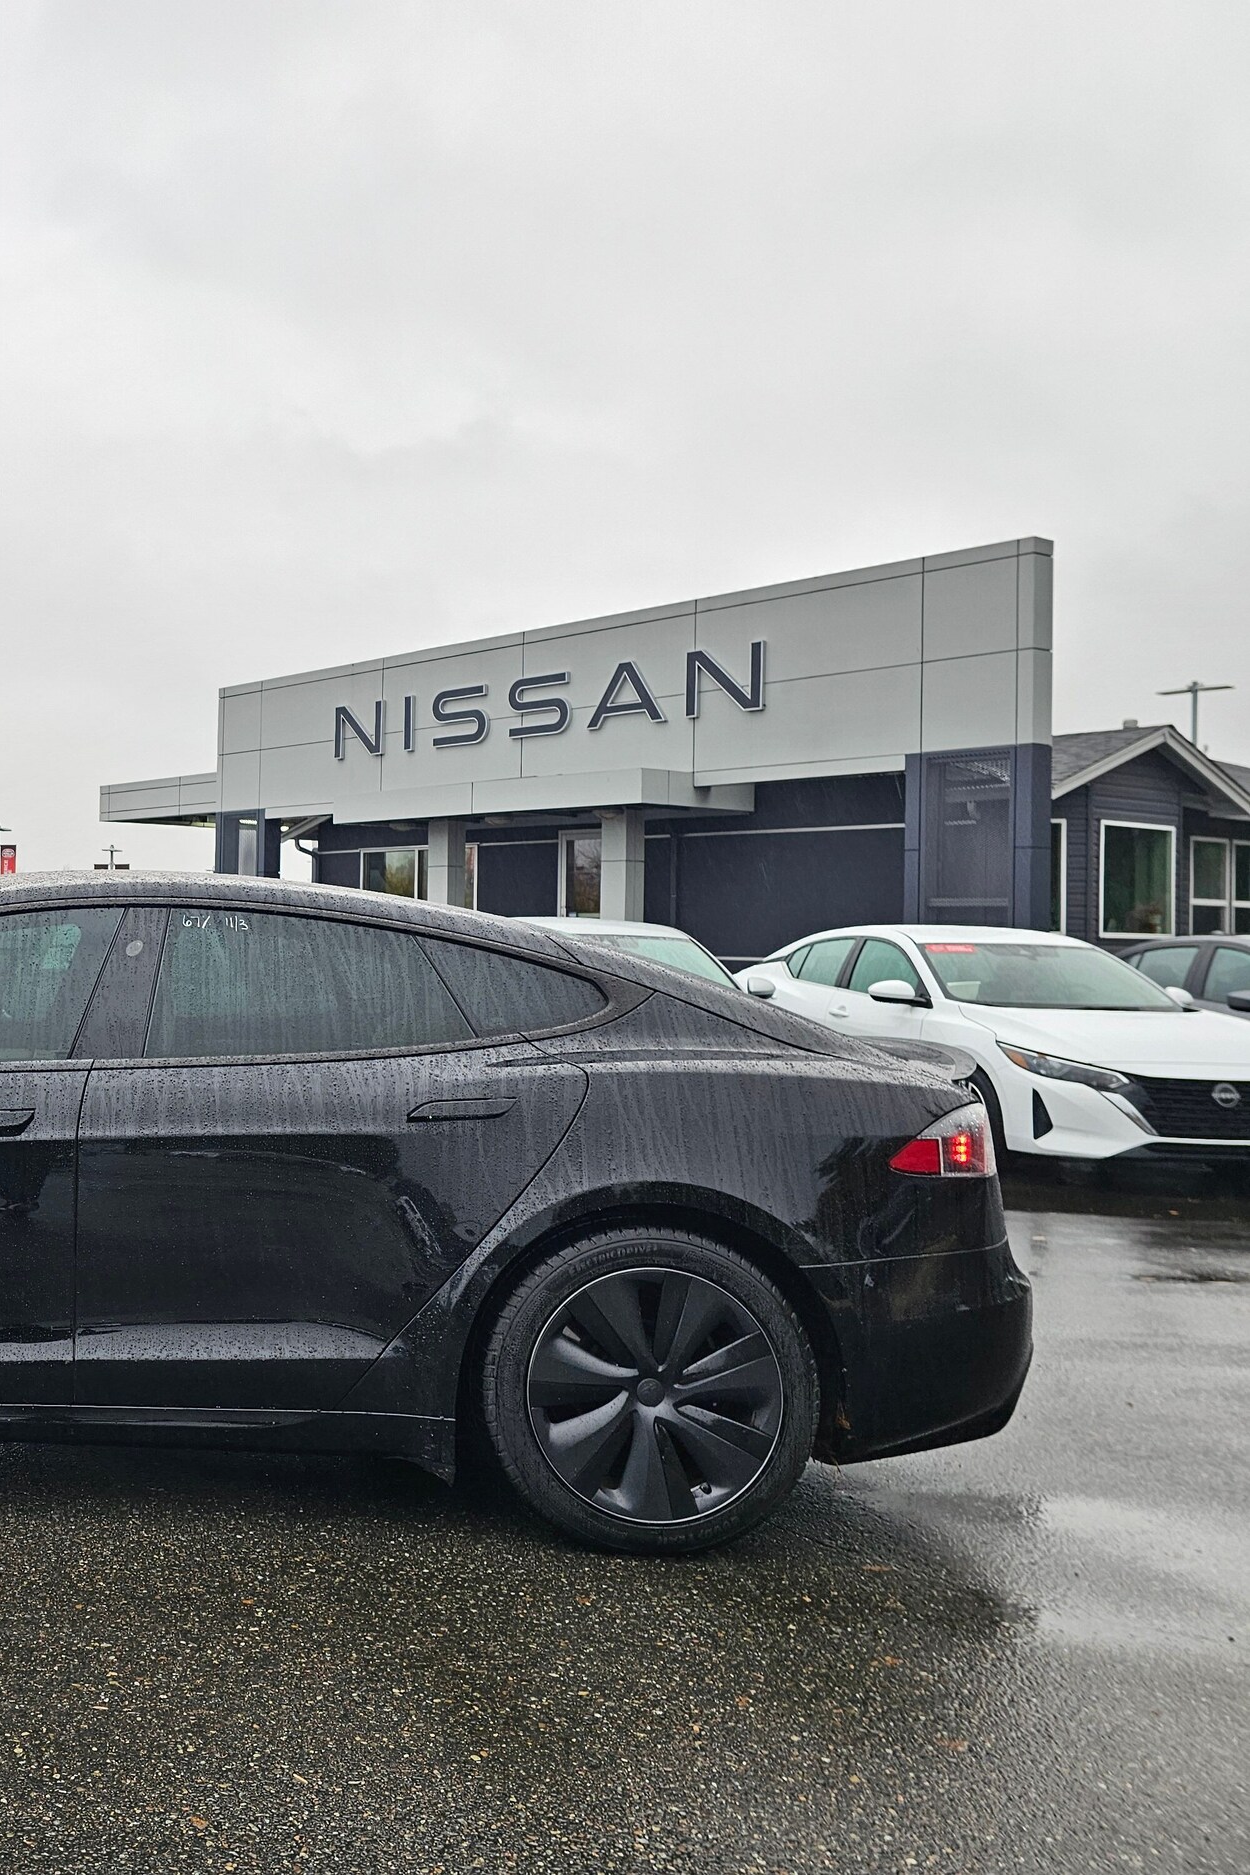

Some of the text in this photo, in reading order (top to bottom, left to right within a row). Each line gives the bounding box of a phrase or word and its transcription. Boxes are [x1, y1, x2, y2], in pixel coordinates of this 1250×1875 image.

[333, 639, 767, 761] NISSAN
[182, 915, 249, 932] 67% 11/3
